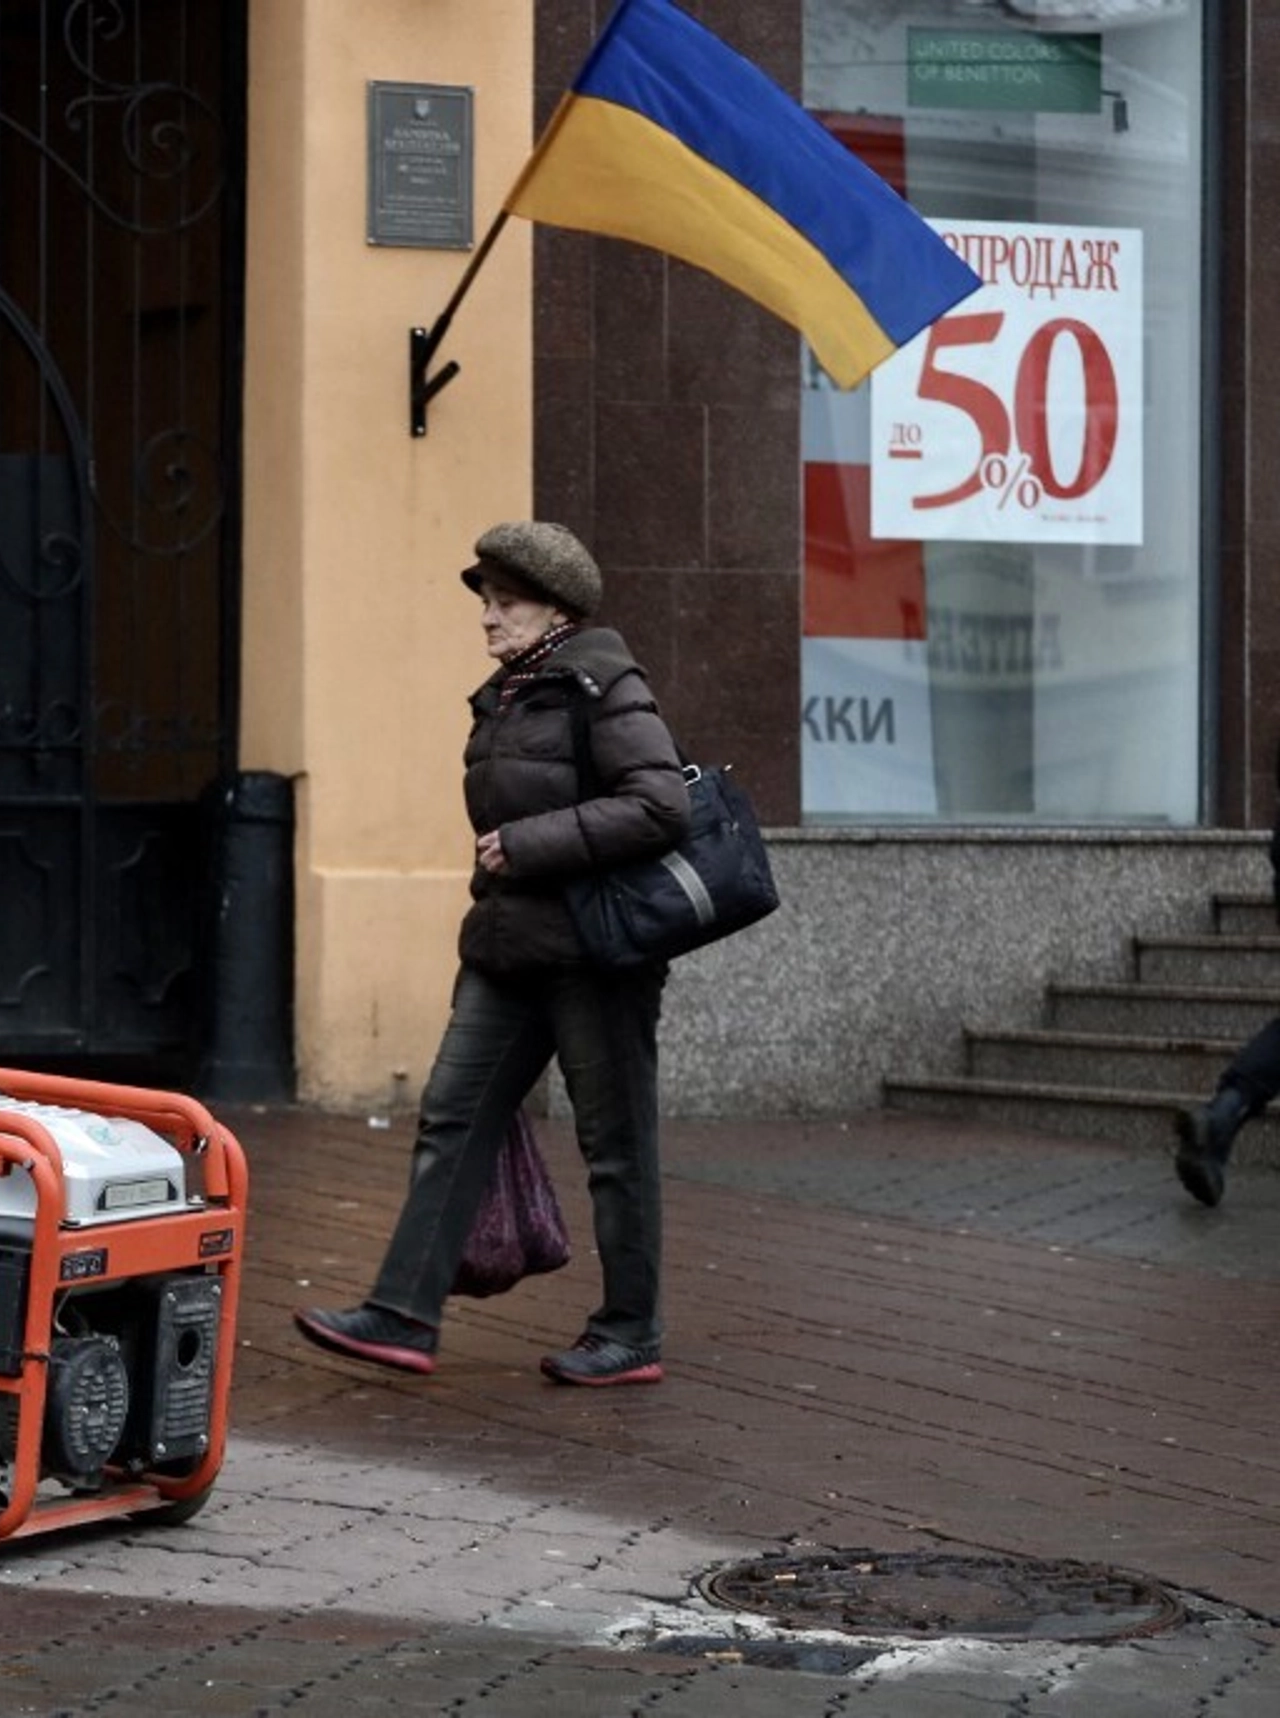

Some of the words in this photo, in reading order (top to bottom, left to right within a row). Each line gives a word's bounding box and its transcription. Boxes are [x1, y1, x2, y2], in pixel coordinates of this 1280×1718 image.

[915, 40, 983, 59] UNITED
[988, 42, 1061, 61] COLORS
[945, 65, 1042, 83] BENETTON
